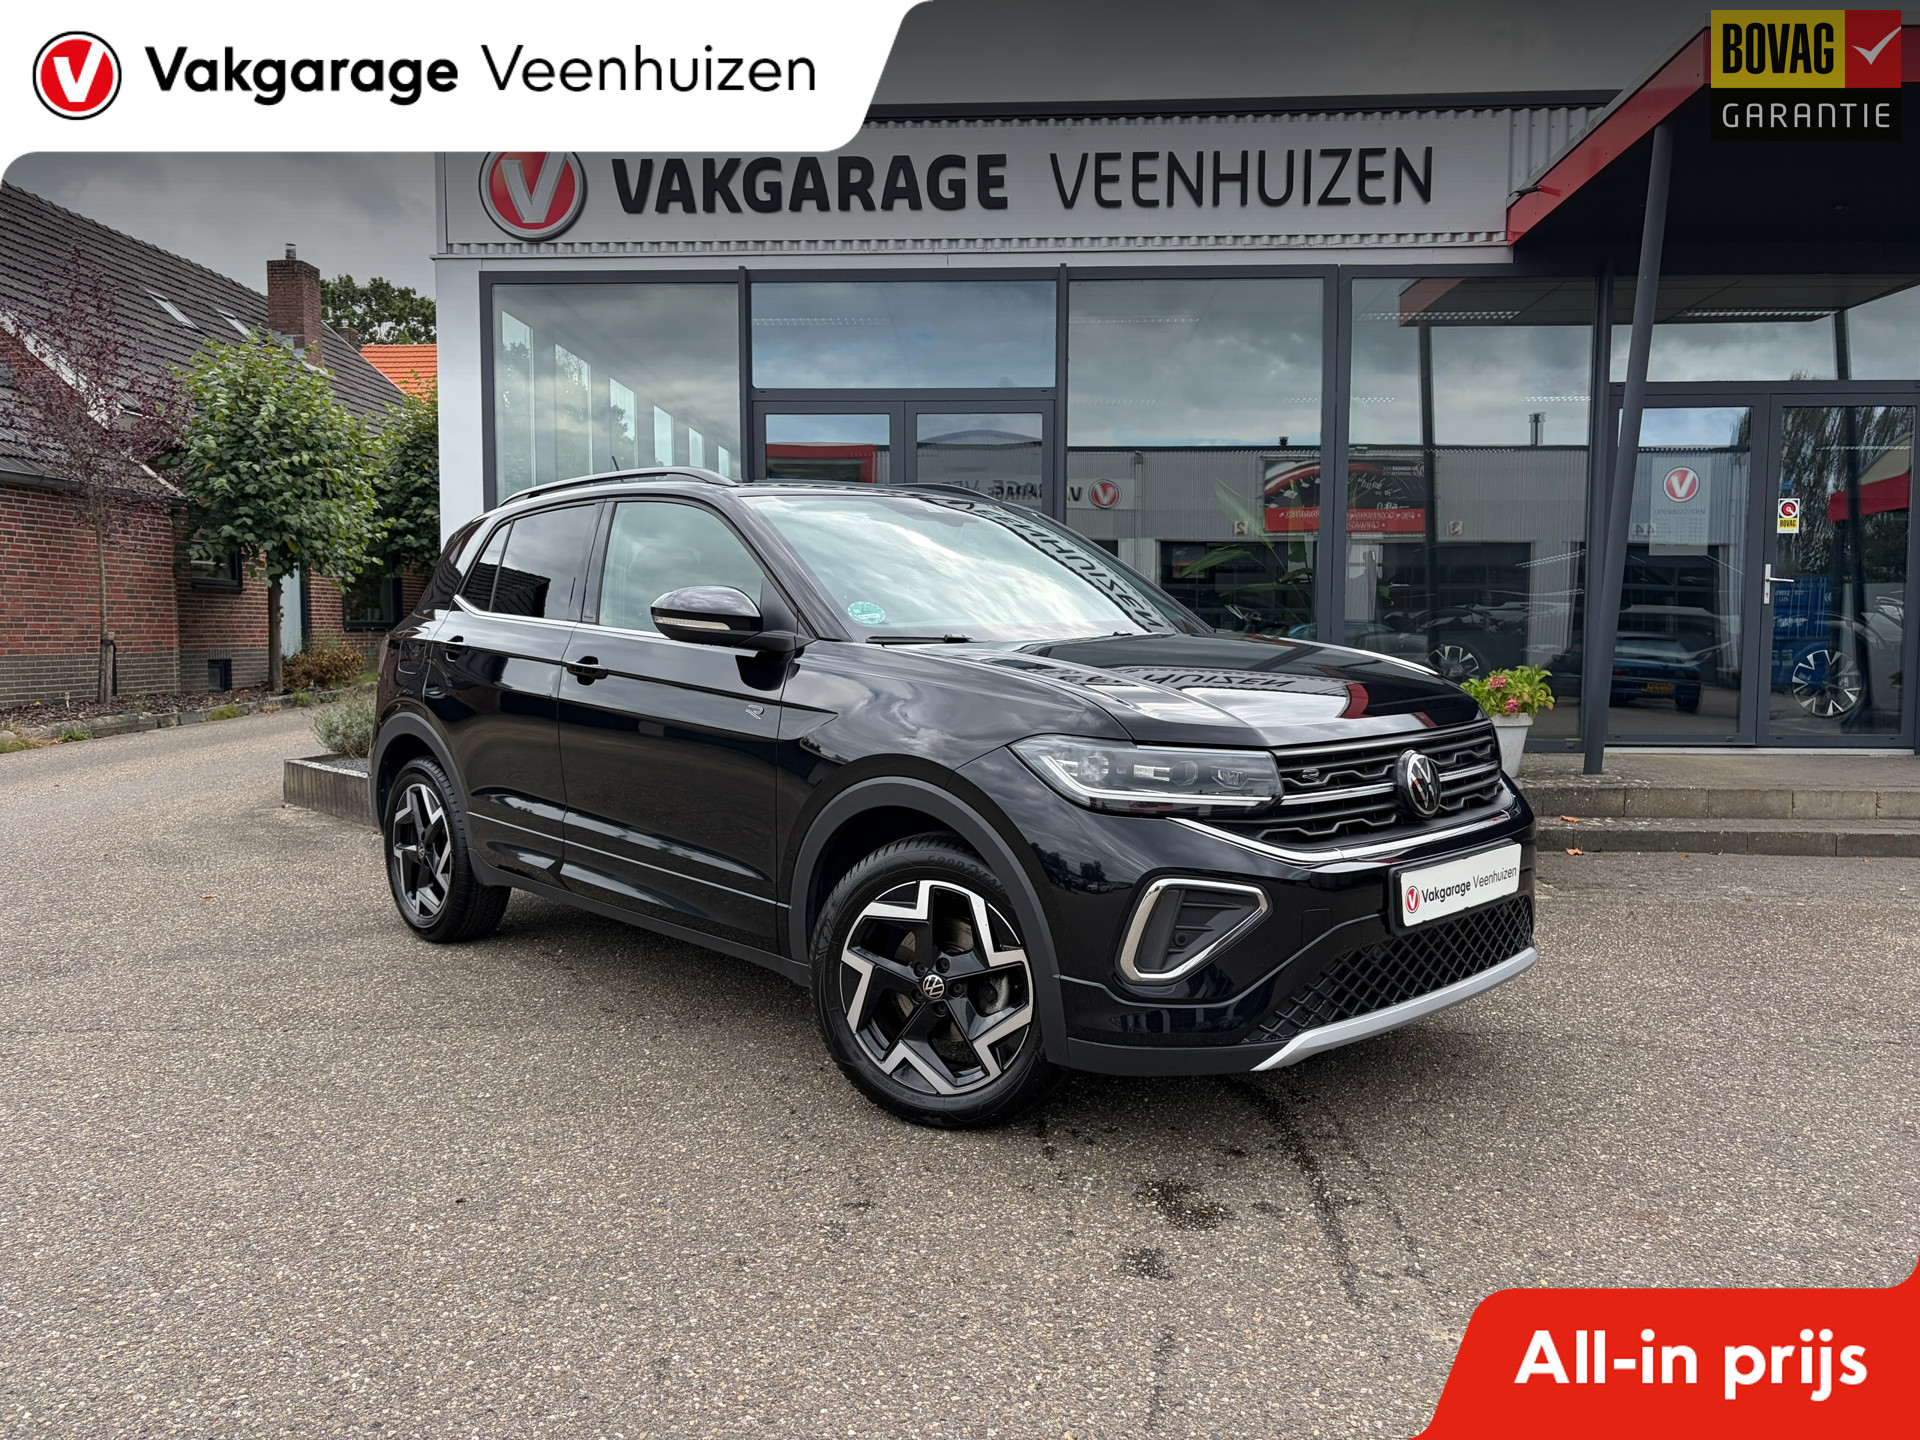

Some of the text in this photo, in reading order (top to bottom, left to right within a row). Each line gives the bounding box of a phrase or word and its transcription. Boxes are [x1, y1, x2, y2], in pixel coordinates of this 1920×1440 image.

[611, 146, 1433, 214] VAKGARAGE VEENHUIZEN
[1779, 519, 1797, 528] BOVAG
[1421, 867, 1517, 903] Vakgarage Veenhuizen
